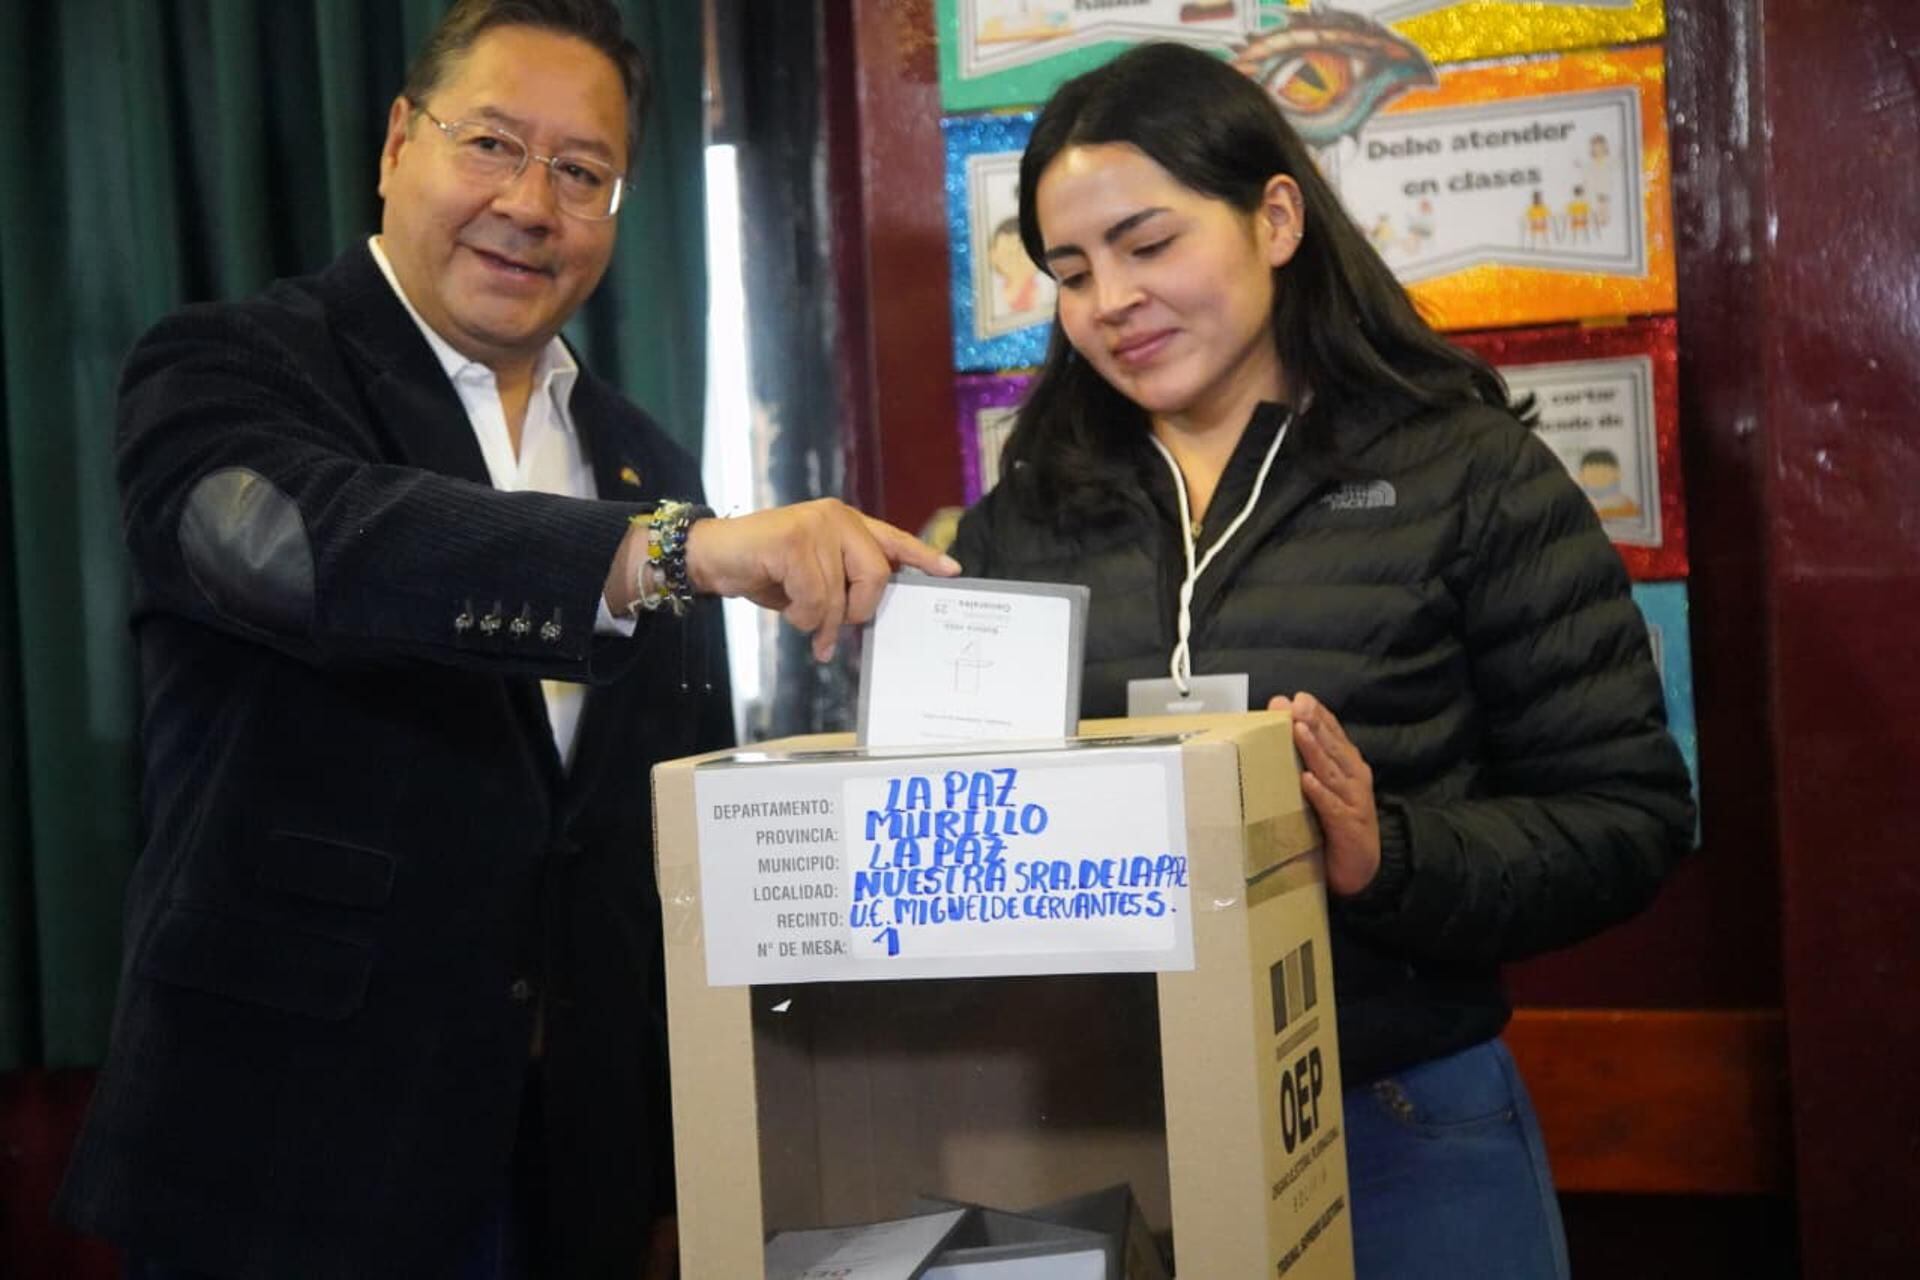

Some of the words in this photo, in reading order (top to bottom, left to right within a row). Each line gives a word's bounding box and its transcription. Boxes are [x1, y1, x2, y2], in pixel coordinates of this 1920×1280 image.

[1367, 137, 1441, 160] Debe
[1451, 120, 1576, 152] atender
[1404, 179, 1439, 197] en
[1448, 168, 1543, 194] clases
[885, 777, 931, 812] LA
[944, 768, 1018, 809] PAZ
[713, 799, 834, 820] DEPARTAMENTO:
[866, 804, 1048, 841] MURILLO
[756, 828, 840, 846] PROVINCIA:
[758, 855, 840, 874] MUNICIPIO:
[869, 837, 921, 870] LA
[934, 836, 1008, 867] PAZ
[754, 883, 838, 902] LOCALIDAD:
[854, 862, 1007, 902] NUESTRA
[777, 912, 844, 929] RECINTO:
[779, 942, 798, 957] DE
[802, 939, 848, 956] MESA:
[872, 927, 900, 957] 1
[1280, 1046, 1323, 1154] OEP
